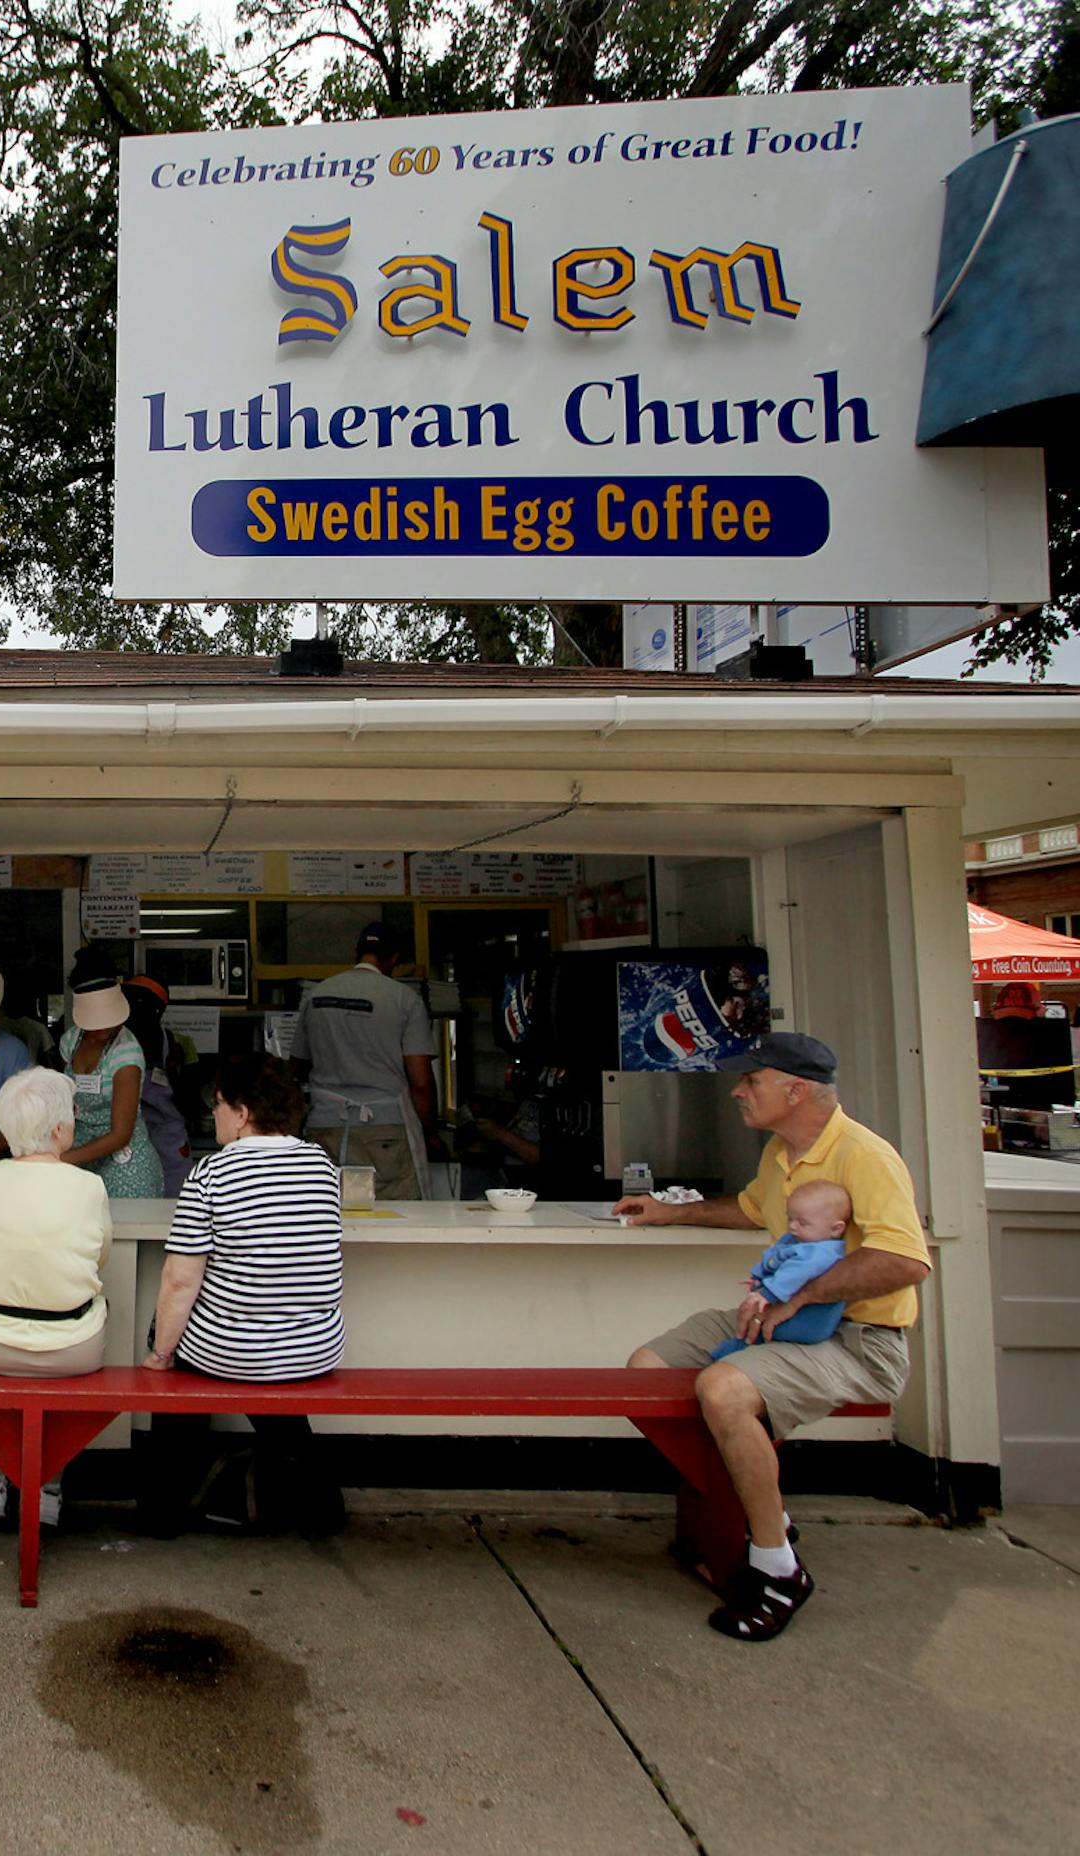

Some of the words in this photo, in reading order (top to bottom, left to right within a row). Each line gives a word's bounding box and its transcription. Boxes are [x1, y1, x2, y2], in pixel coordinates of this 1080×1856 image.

[151, 151, 381, 189] Celebrating
[388, 145, 441, 177] 60
[450, 141, 554, 171] Years
[568, 131, 614, 164] of
[621, 130, 735, 162] Great
[746, 119, 864, 156] Food!
[271, 211, 801, 345] Salem
[143, 381, 519, 451] Lutheran
[564, 369, 880, 446] Church
[246, 486, 460, 543] Swedish
[480, 485, 575, 552] Egg
[596, 483, 771, 542] Coffee
[991, 958, 1010, 974] Free
[1011, 956, 1031, 974] Coin
[1031, 957, 1072, 977] Counting
[672, 988, 721, 1052] PEPS
